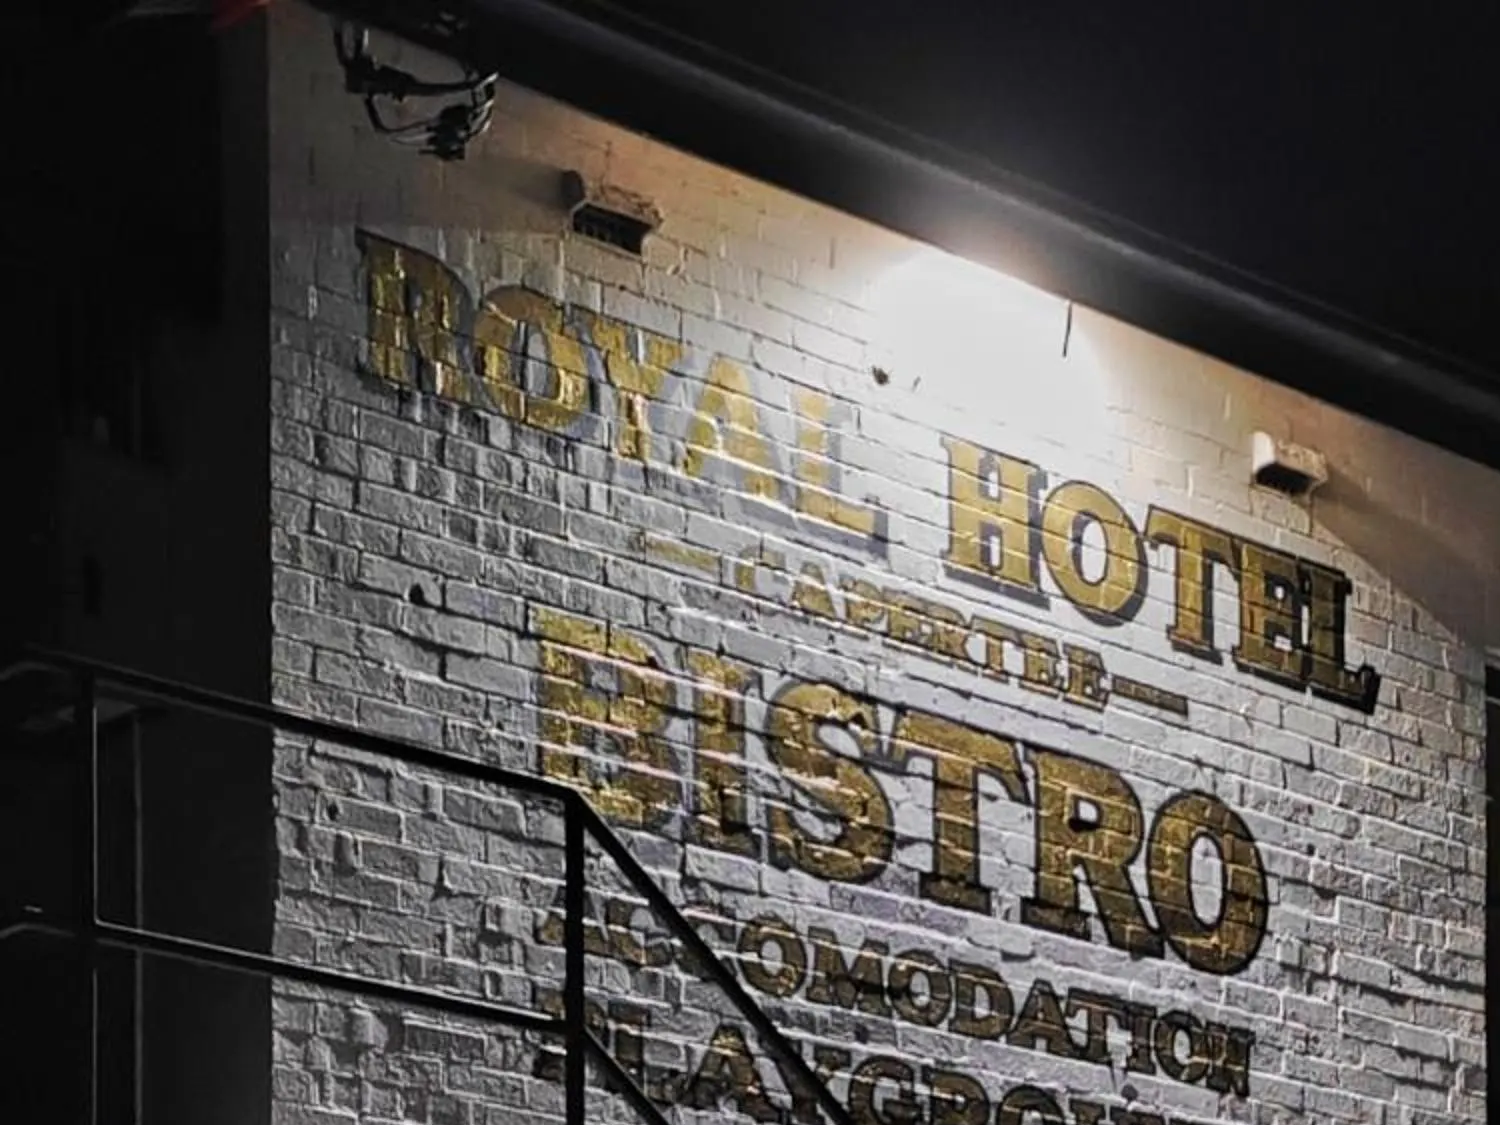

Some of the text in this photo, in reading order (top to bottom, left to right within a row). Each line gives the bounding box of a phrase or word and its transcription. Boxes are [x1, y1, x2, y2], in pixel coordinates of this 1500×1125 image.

[355, 227, 1381, 715] ROYAL HOTEL
[527, 602, 1269, 976] BISTRO
